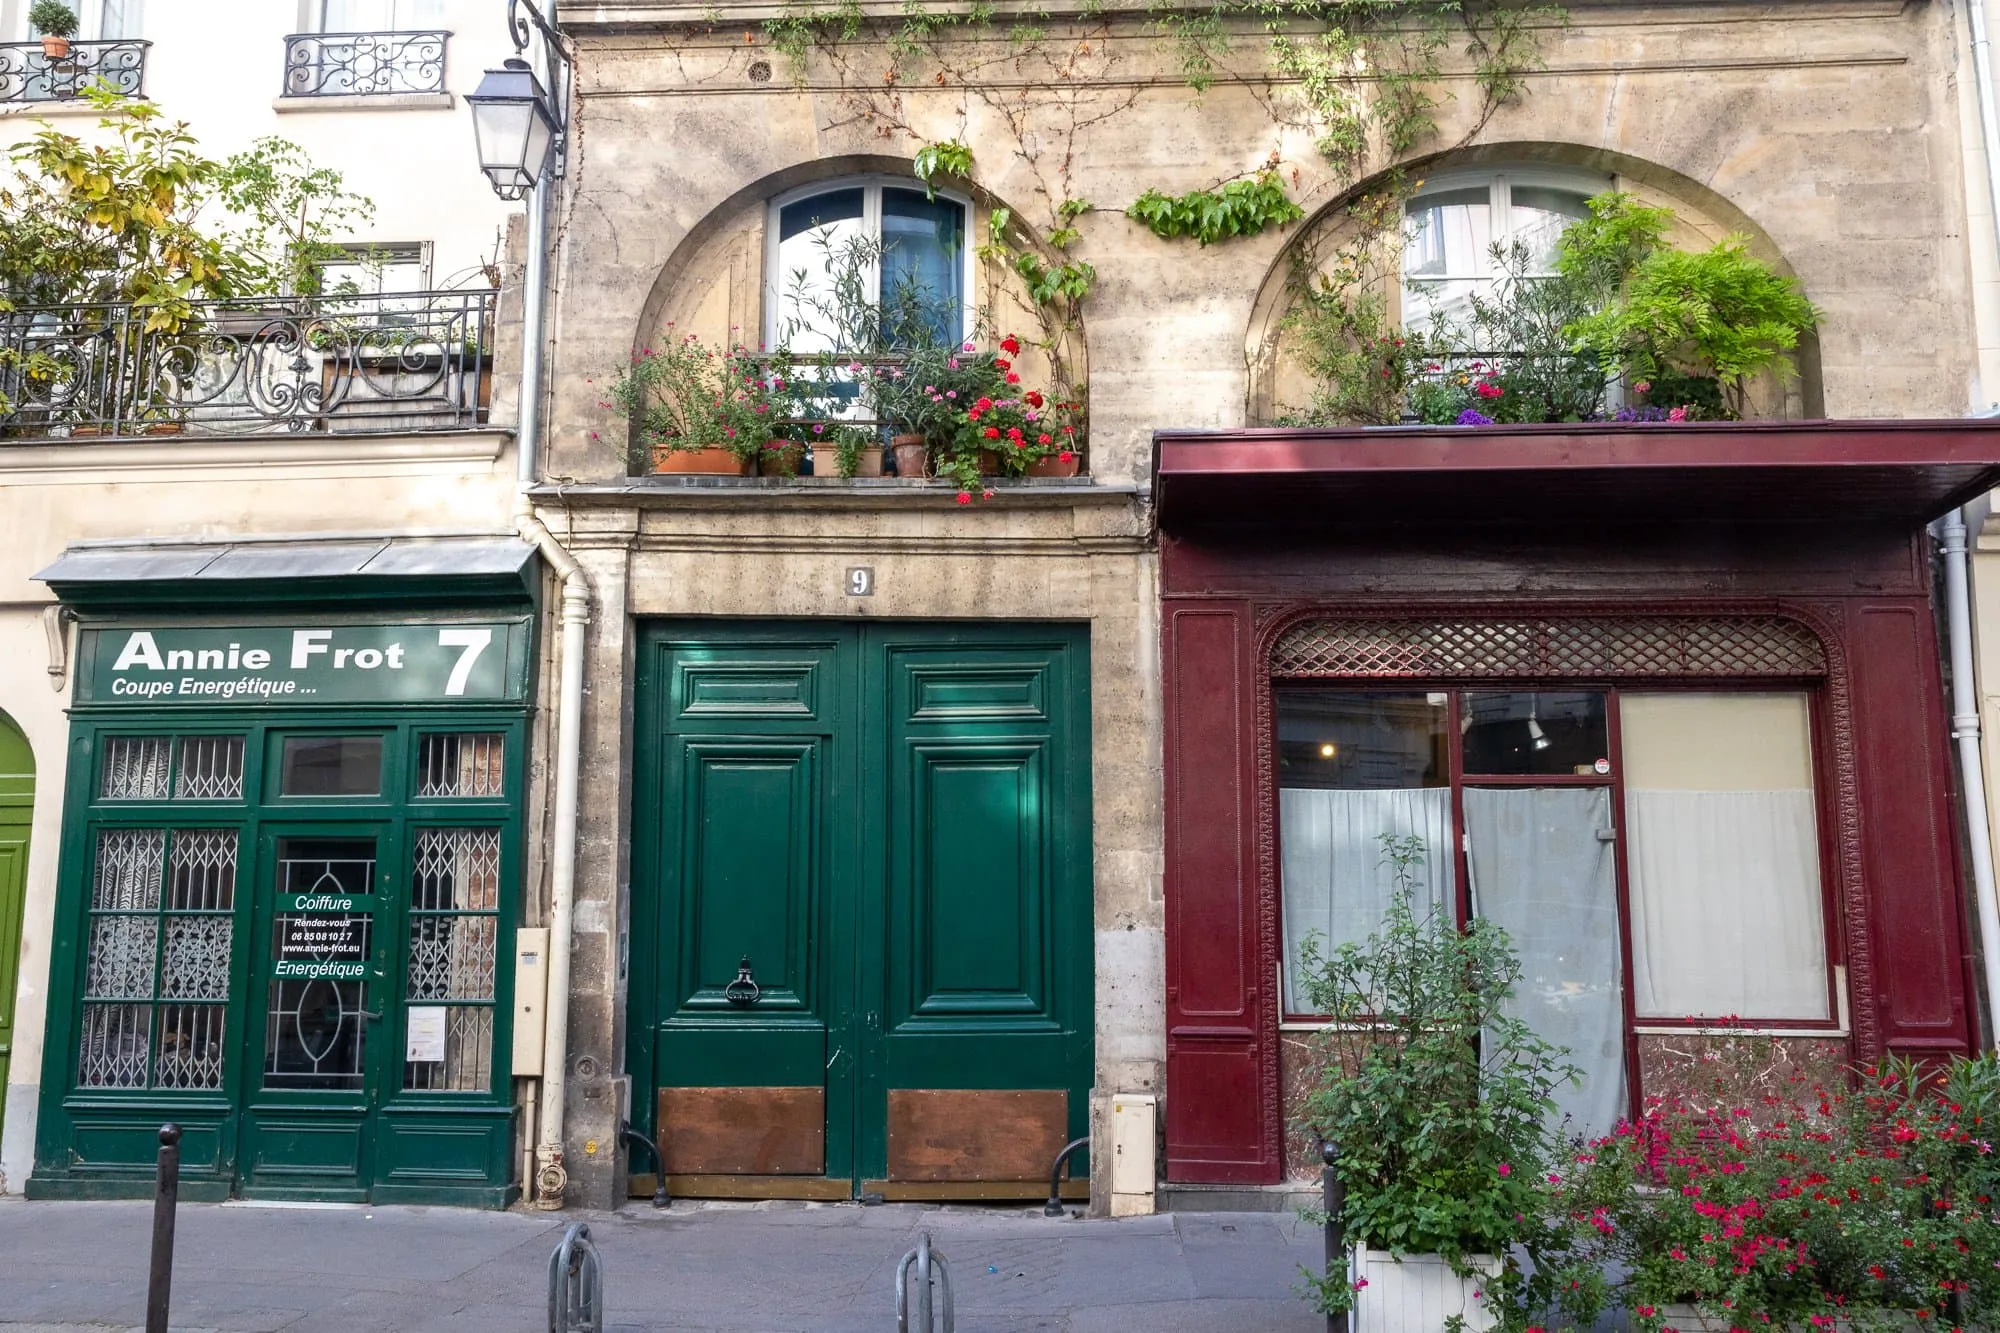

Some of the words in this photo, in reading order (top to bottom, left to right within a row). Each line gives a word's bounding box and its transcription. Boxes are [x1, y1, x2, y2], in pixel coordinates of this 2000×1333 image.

[852, 570, 867, 593] 9
[112, 631, 271, 671] Annie
[290, 630, 404, 669] Frot
[438, 629, 492, 696] 7
[111, 678, 174, 696] Coupe
[178, 676, 296, 698] Energétique
[295, 896, 352, 910] Coiffure
[294, 919, 351, 928] Rendez-vous
[281, 944, 360, 953] www.annie-frot.eu
[275, 961, 364, 979] Energétique
